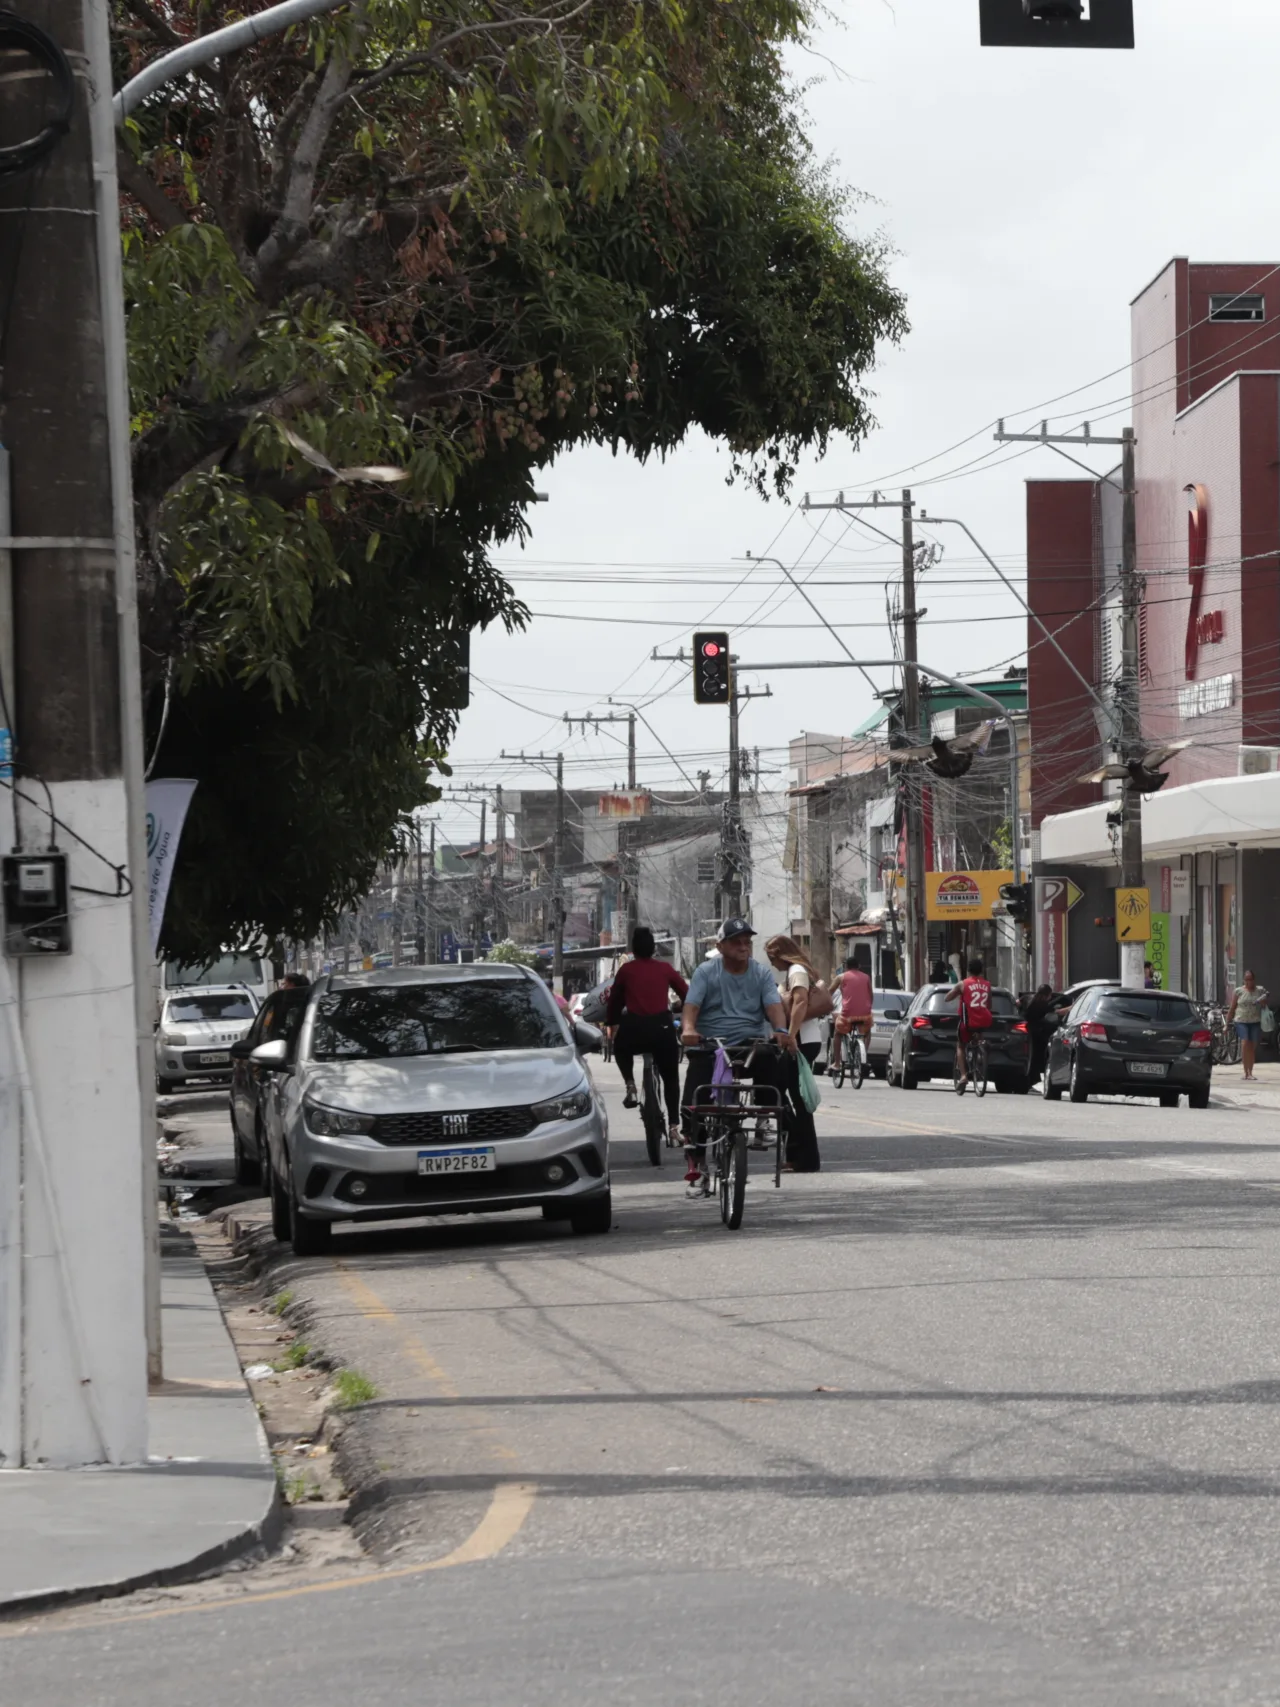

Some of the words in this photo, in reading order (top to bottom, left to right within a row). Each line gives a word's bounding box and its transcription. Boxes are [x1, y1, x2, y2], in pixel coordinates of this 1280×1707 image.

[970, 991, 989, 1008] 22
[442, 1114, 468, 1136] FIAT
[425, 1155, 488, 1172] RWP2F82
